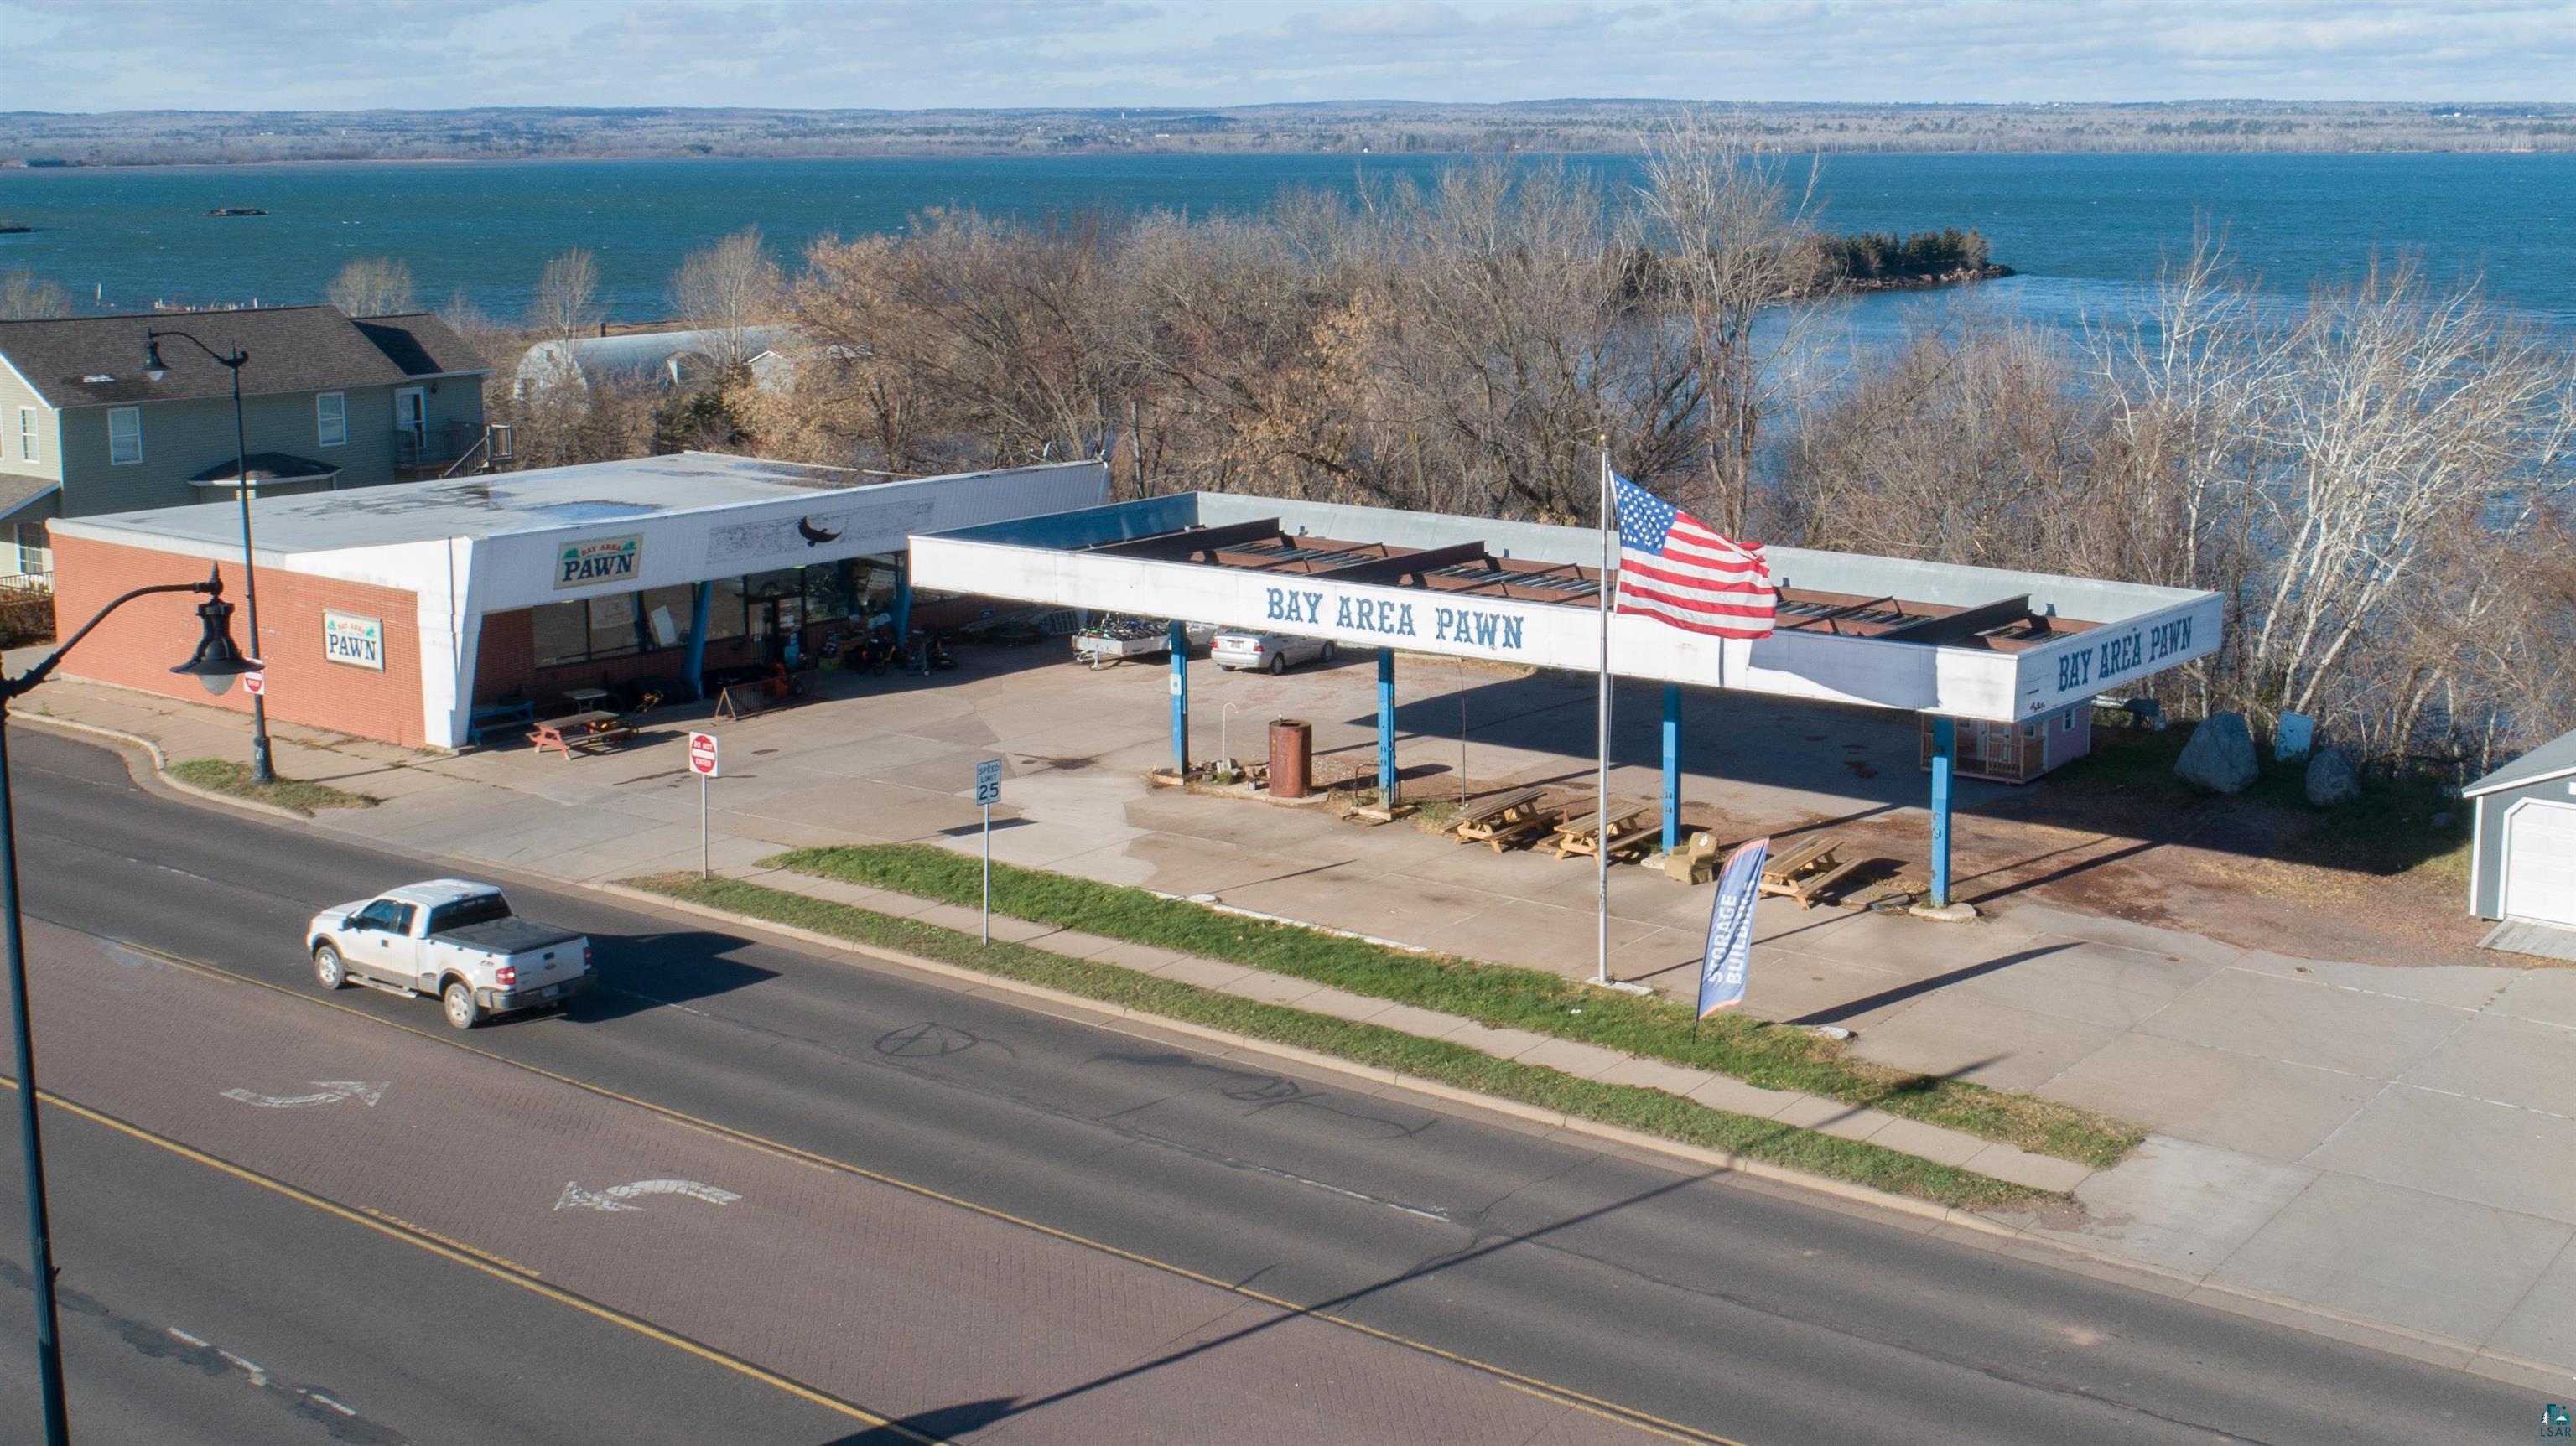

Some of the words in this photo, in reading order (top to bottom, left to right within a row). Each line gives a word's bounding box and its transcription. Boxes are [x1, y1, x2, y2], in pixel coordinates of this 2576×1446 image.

[580, 547, 597, 556] BAY
[563, 553, 635, 582] PAWN
[1267, 588, 1323, 625] BAY
[1336, 596, 1416, 636] AREA
[1435, 607, 1524, 649] PAWN
[329, 633, 376, 661] PAWN
[2057, 647, 2093, 692] BAY
[2098, 631, 2142, 679] AREA
[2148, 616, 2192, 663] PAWN
[979, 782, 999, 800] 25
[1707, 894, 1737, 982] STORAGE
